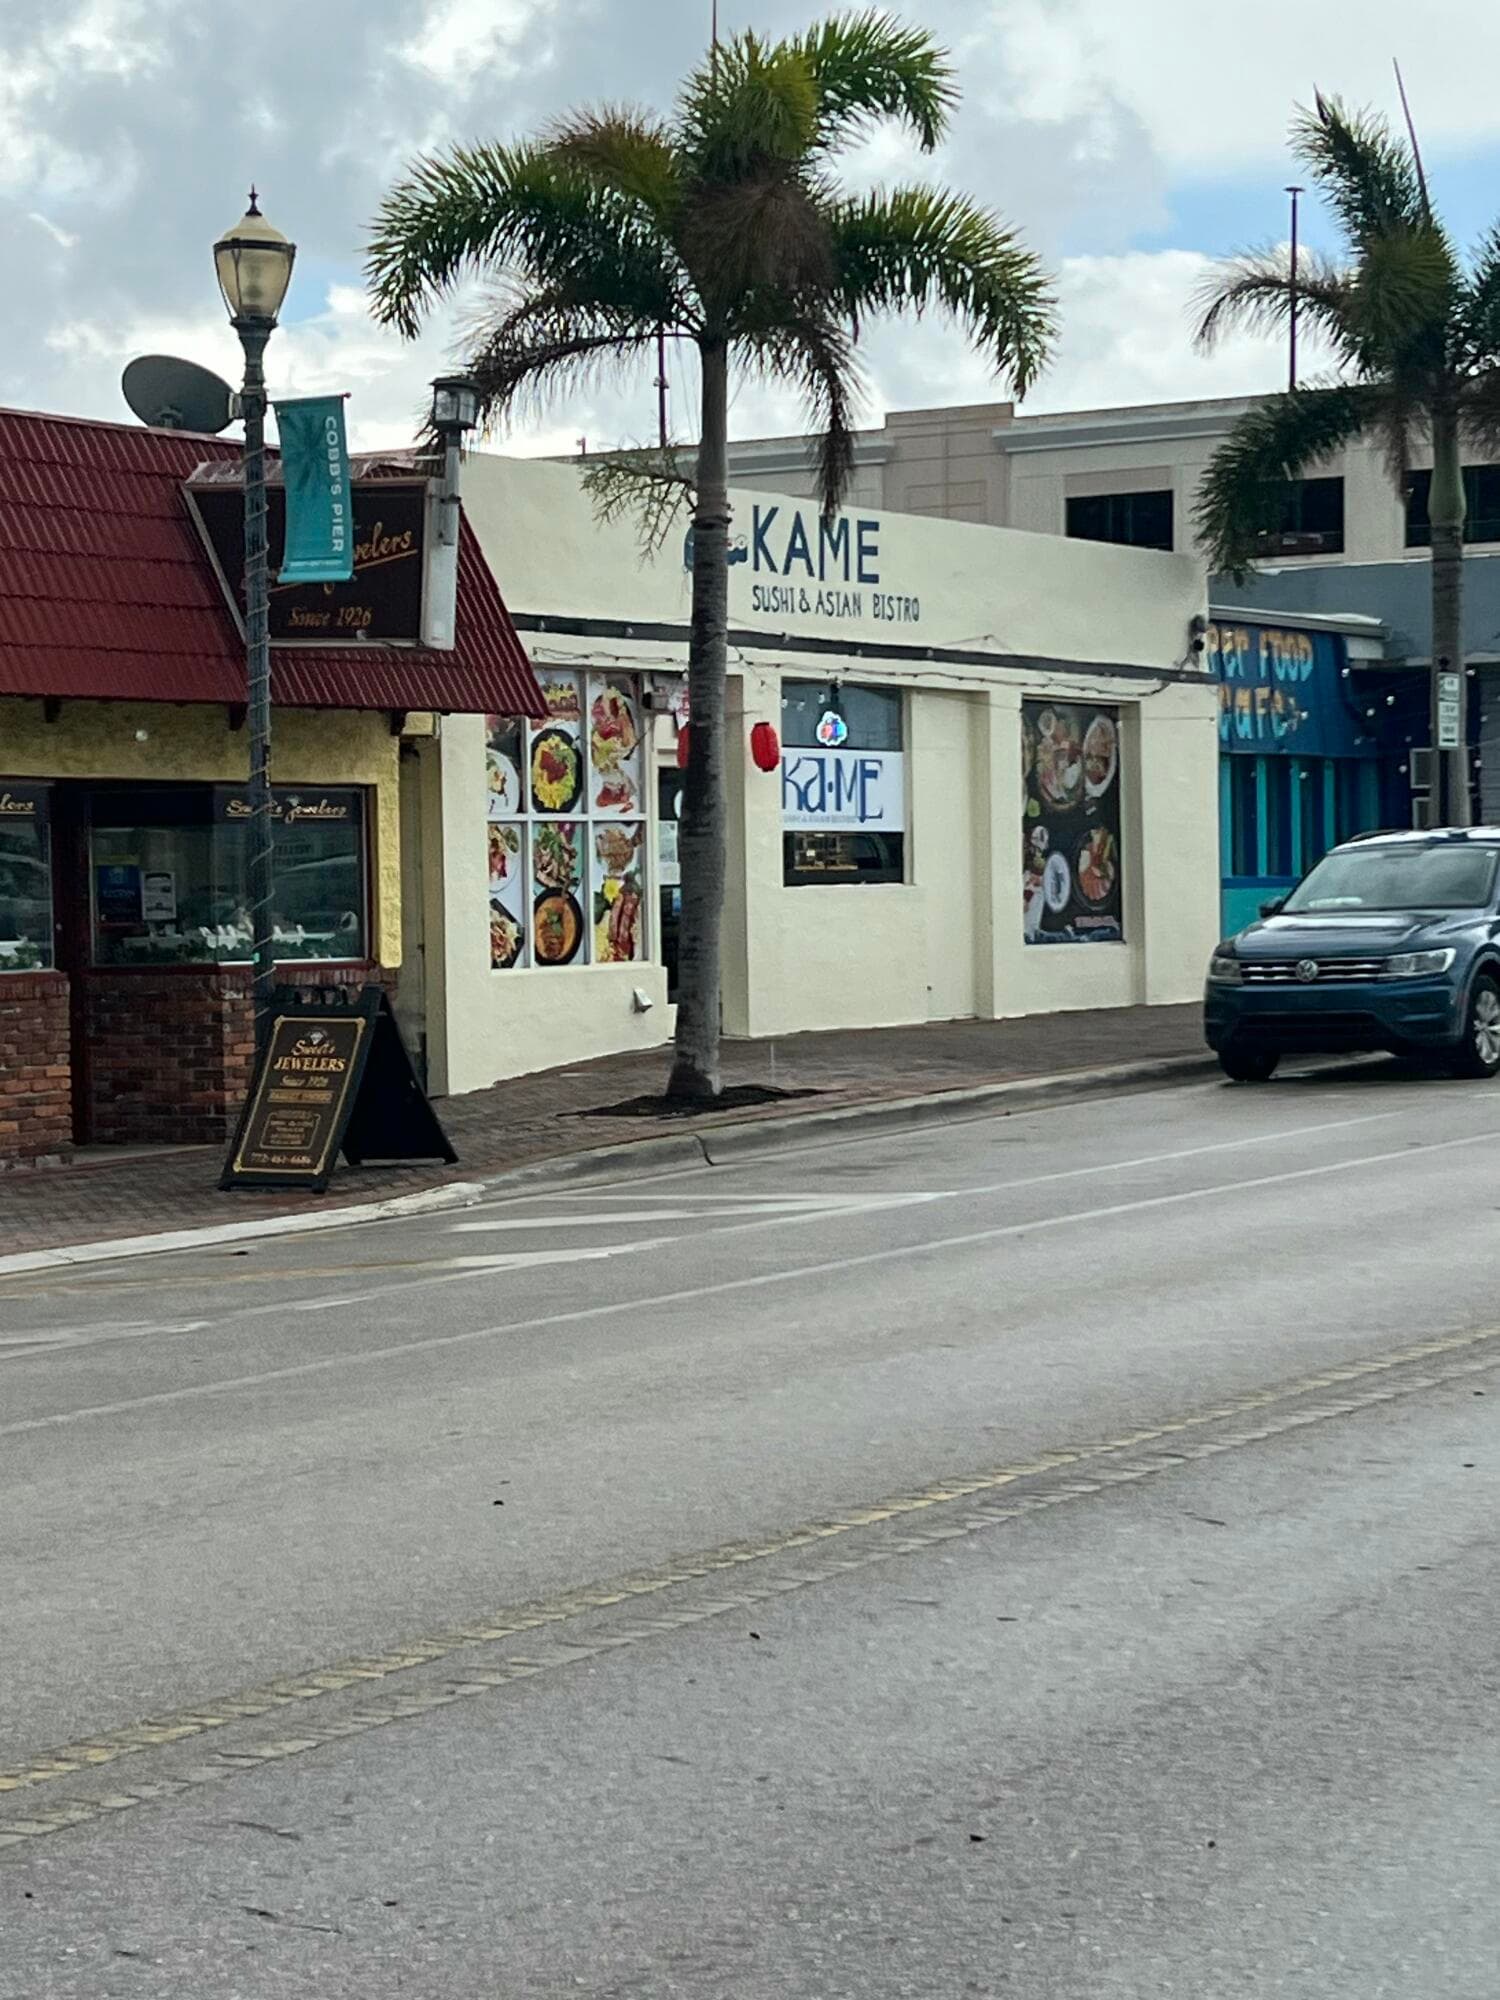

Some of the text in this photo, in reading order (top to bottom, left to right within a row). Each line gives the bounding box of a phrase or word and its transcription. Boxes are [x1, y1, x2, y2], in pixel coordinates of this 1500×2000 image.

[325, 416, 344, 552] COBB'S PIER
[752, 504, 880, 585] KAME
[752, 585, 921, 622] SUSHI & ASIAN BISTRO
[273, 1056, 346, 1072] JEWELERS
